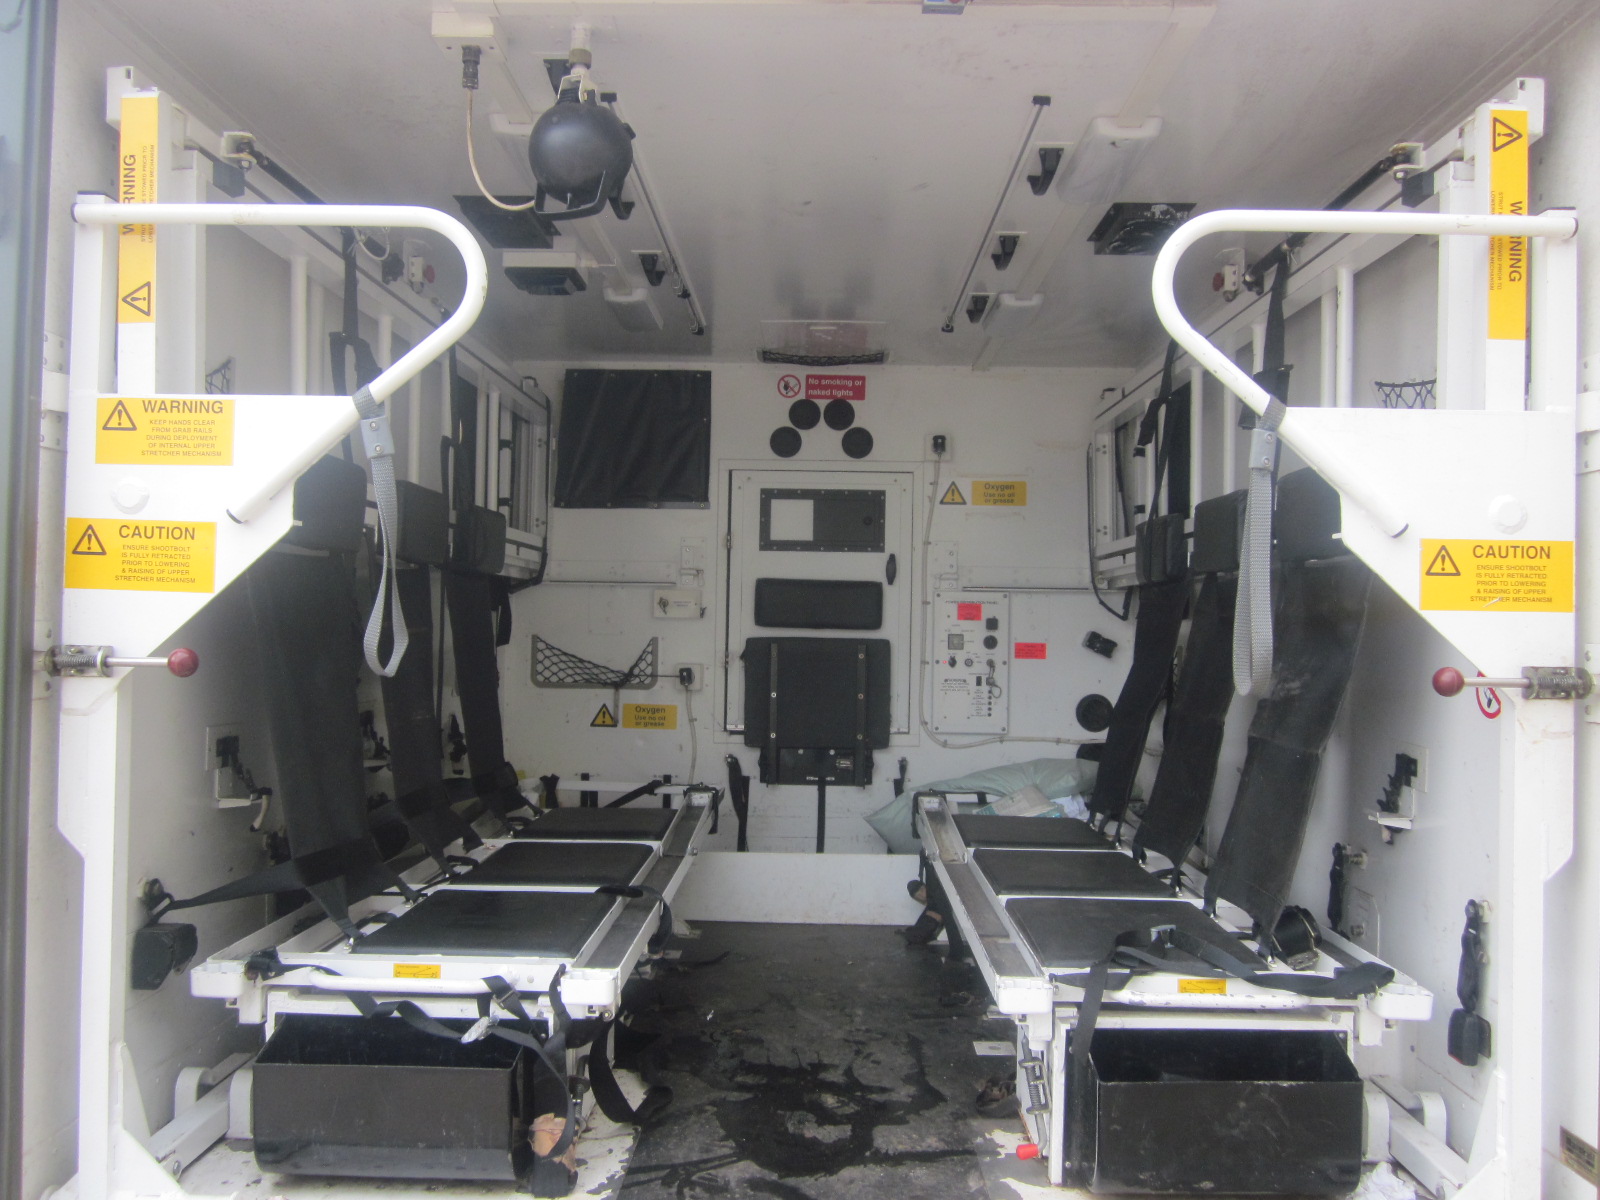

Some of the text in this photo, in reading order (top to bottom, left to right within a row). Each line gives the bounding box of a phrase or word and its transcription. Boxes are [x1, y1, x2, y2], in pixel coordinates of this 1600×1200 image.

[122, 155, 136, 235] WRNING
[1509, 201, 1523, 282] WNING
[142, 400, 224, 414] WARNING
[984, 483, 1014, 491] Oxygen
[119, 525, 195, 540] CAUTION
[1473, 545, 1551, 559] CAUTION
[635, 706, 665, 714] Oxygen
